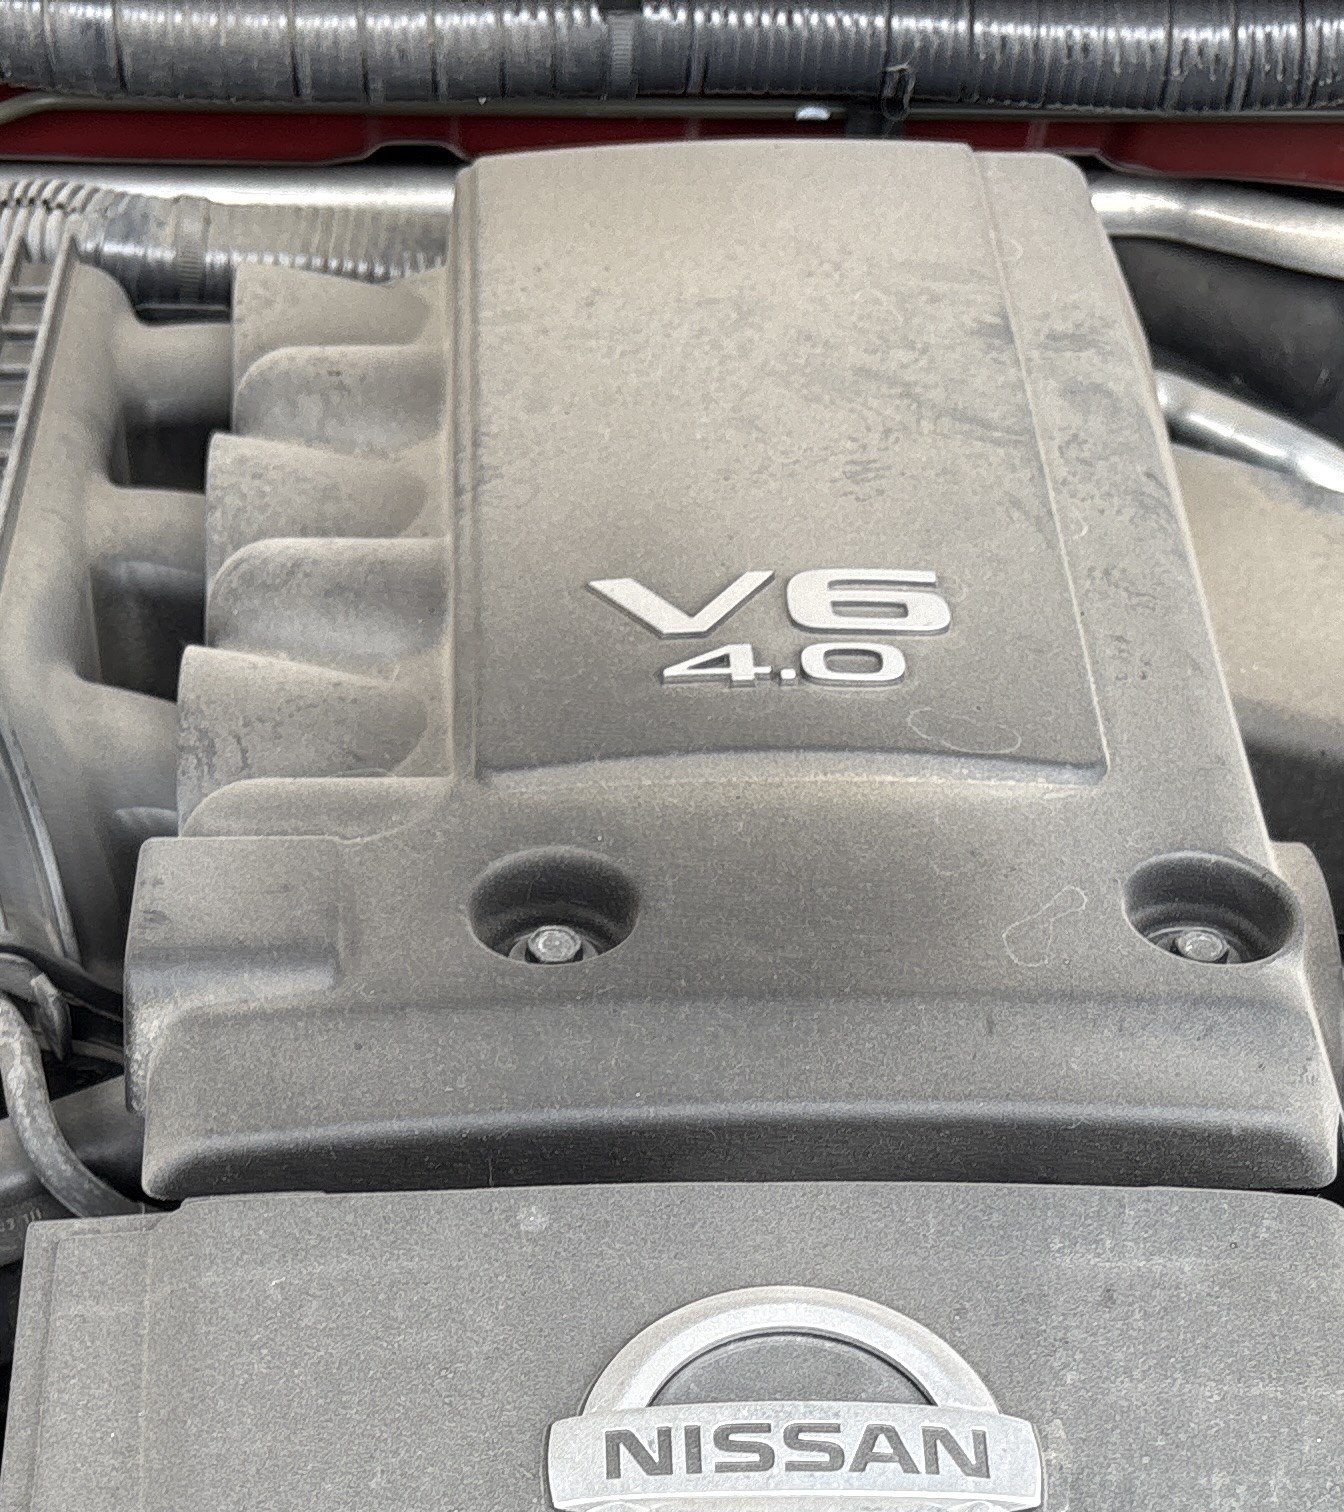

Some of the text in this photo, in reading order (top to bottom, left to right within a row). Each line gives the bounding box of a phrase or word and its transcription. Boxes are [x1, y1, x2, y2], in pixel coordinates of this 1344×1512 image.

[586, 568, 951, 640] V6
[661, 642, 906, 687] 4.0
[604, 1421, 992, 1480] NISSAN
